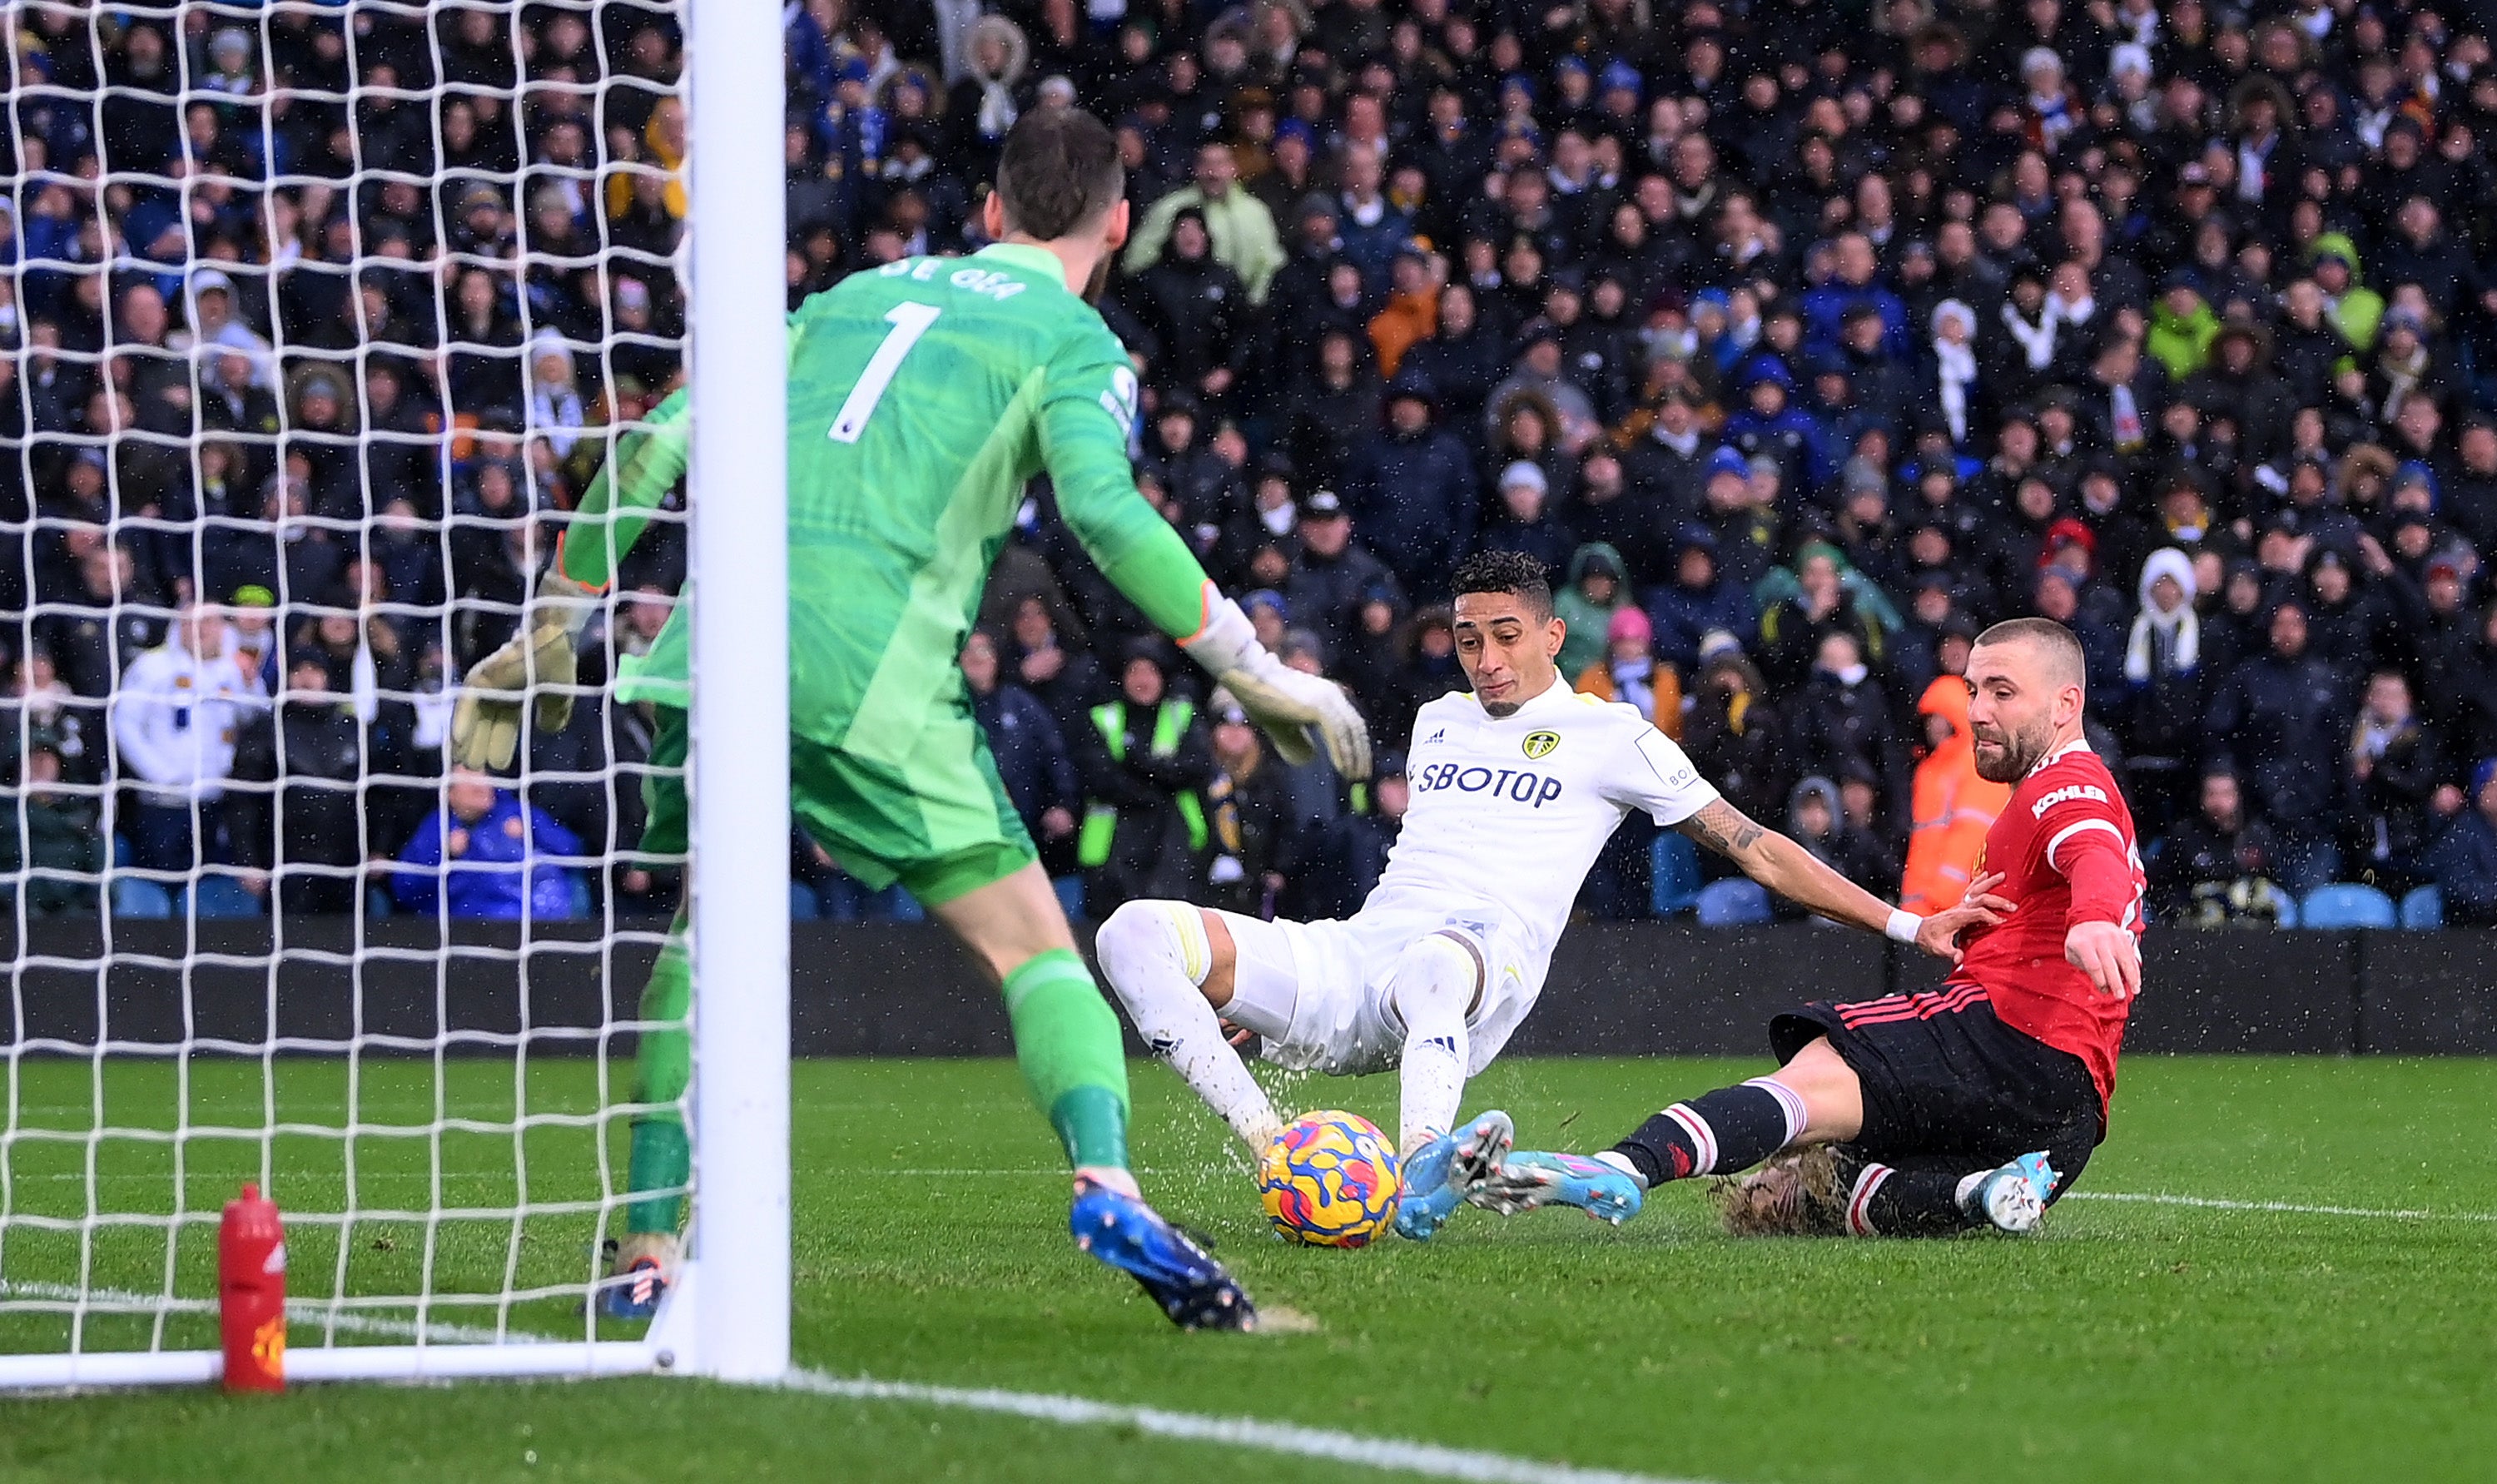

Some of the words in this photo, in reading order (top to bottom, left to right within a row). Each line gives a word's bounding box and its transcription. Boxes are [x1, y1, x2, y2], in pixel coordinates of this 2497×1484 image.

[828, 300, 941, 443] 1
[1418, 763, 1562, 809] SBOTOP
[2031, 785, 2107, 821] KOHLER
